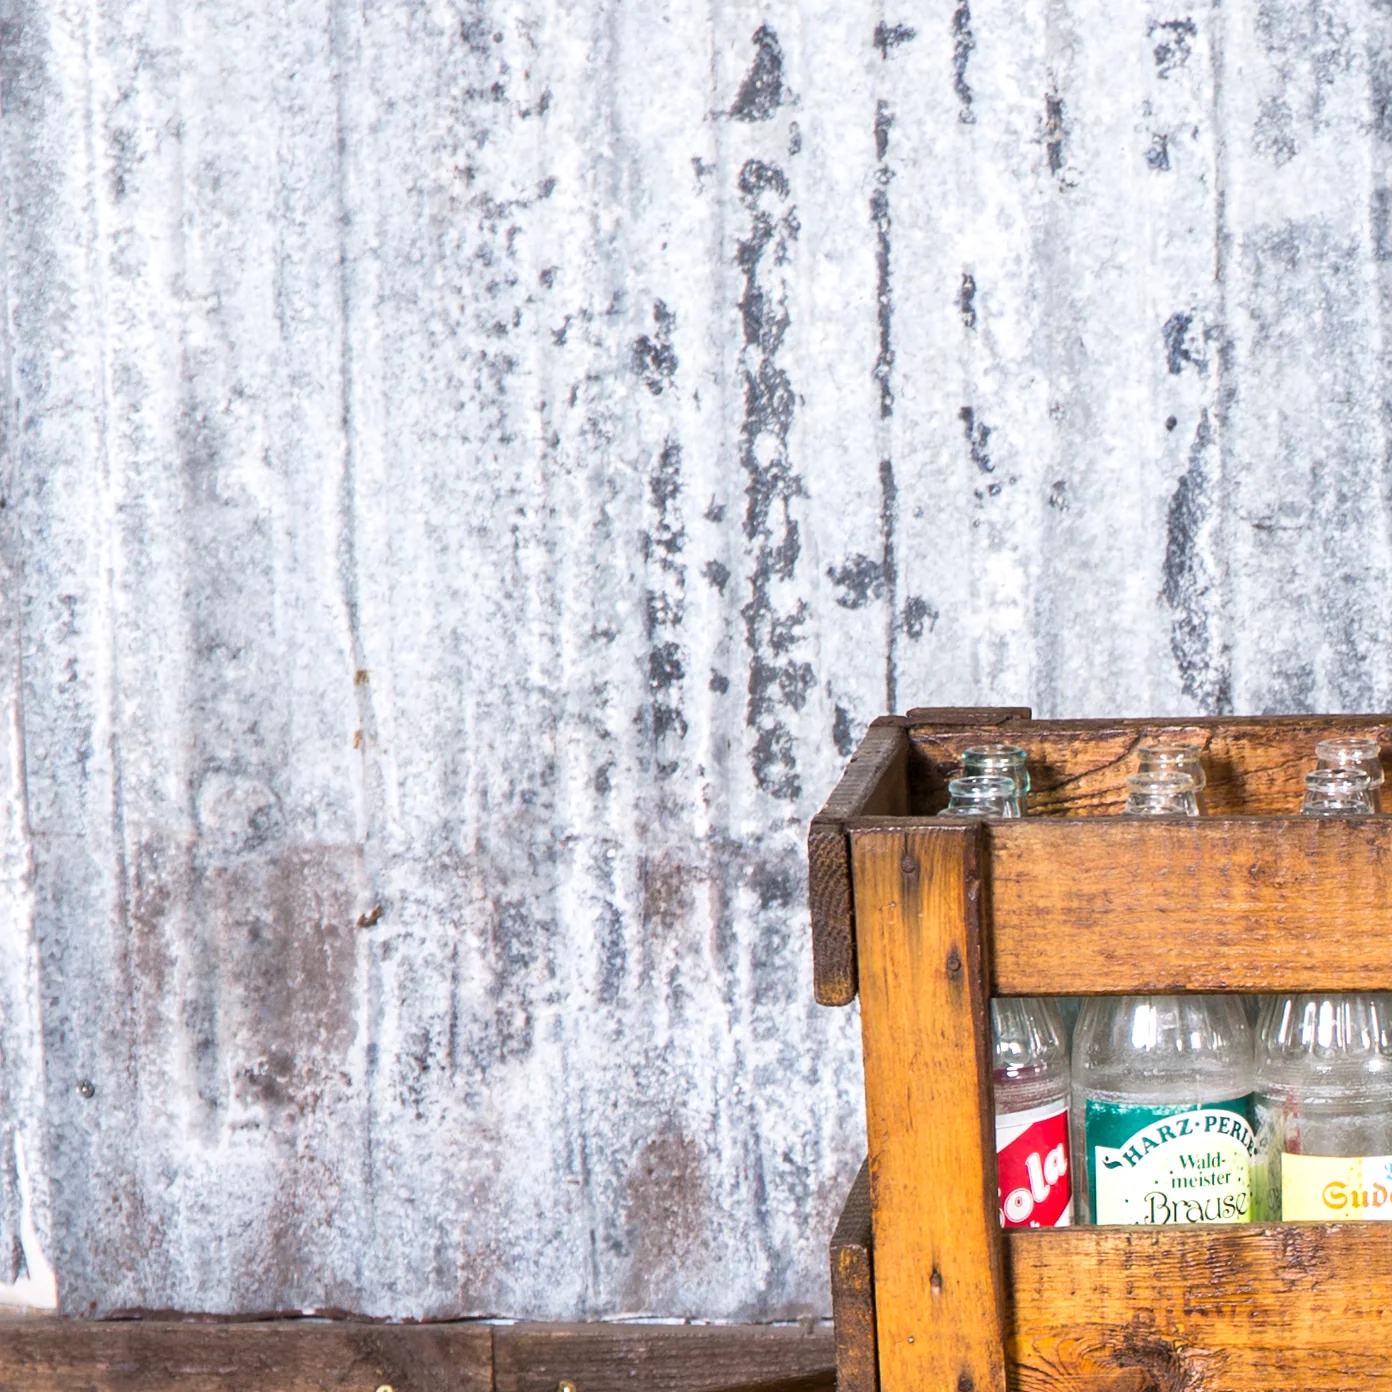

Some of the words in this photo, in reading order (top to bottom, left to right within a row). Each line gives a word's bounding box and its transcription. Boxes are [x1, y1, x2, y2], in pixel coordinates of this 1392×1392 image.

[1179, 1151, 1226, 1170] Wald-
[998, 1143, 1068, 1228] ola
[1171, 1170, 1231, 1190] meister
[1143, 1190, 1248, 1225] Brause
